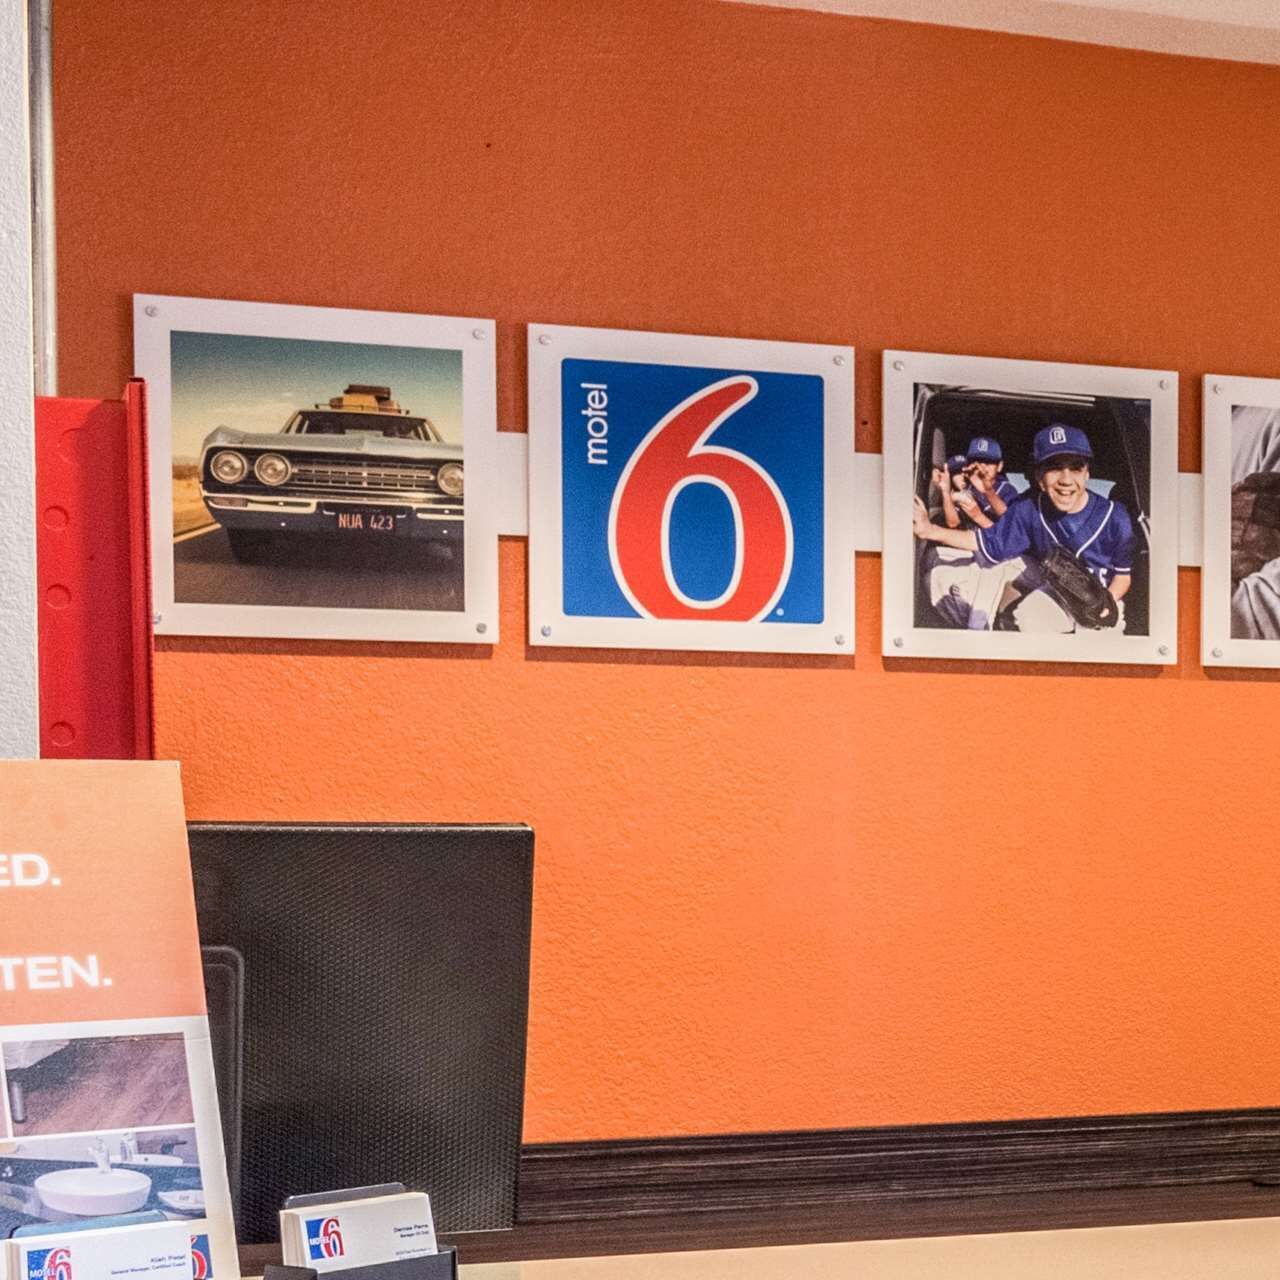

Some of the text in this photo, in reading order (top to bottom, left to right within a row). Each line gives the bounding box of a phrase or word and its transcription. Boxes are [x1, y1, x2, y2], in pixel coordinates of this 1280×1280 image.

[338, 512, 394, 530] NUA 423
[580, 374, 795, 623] motel 6
